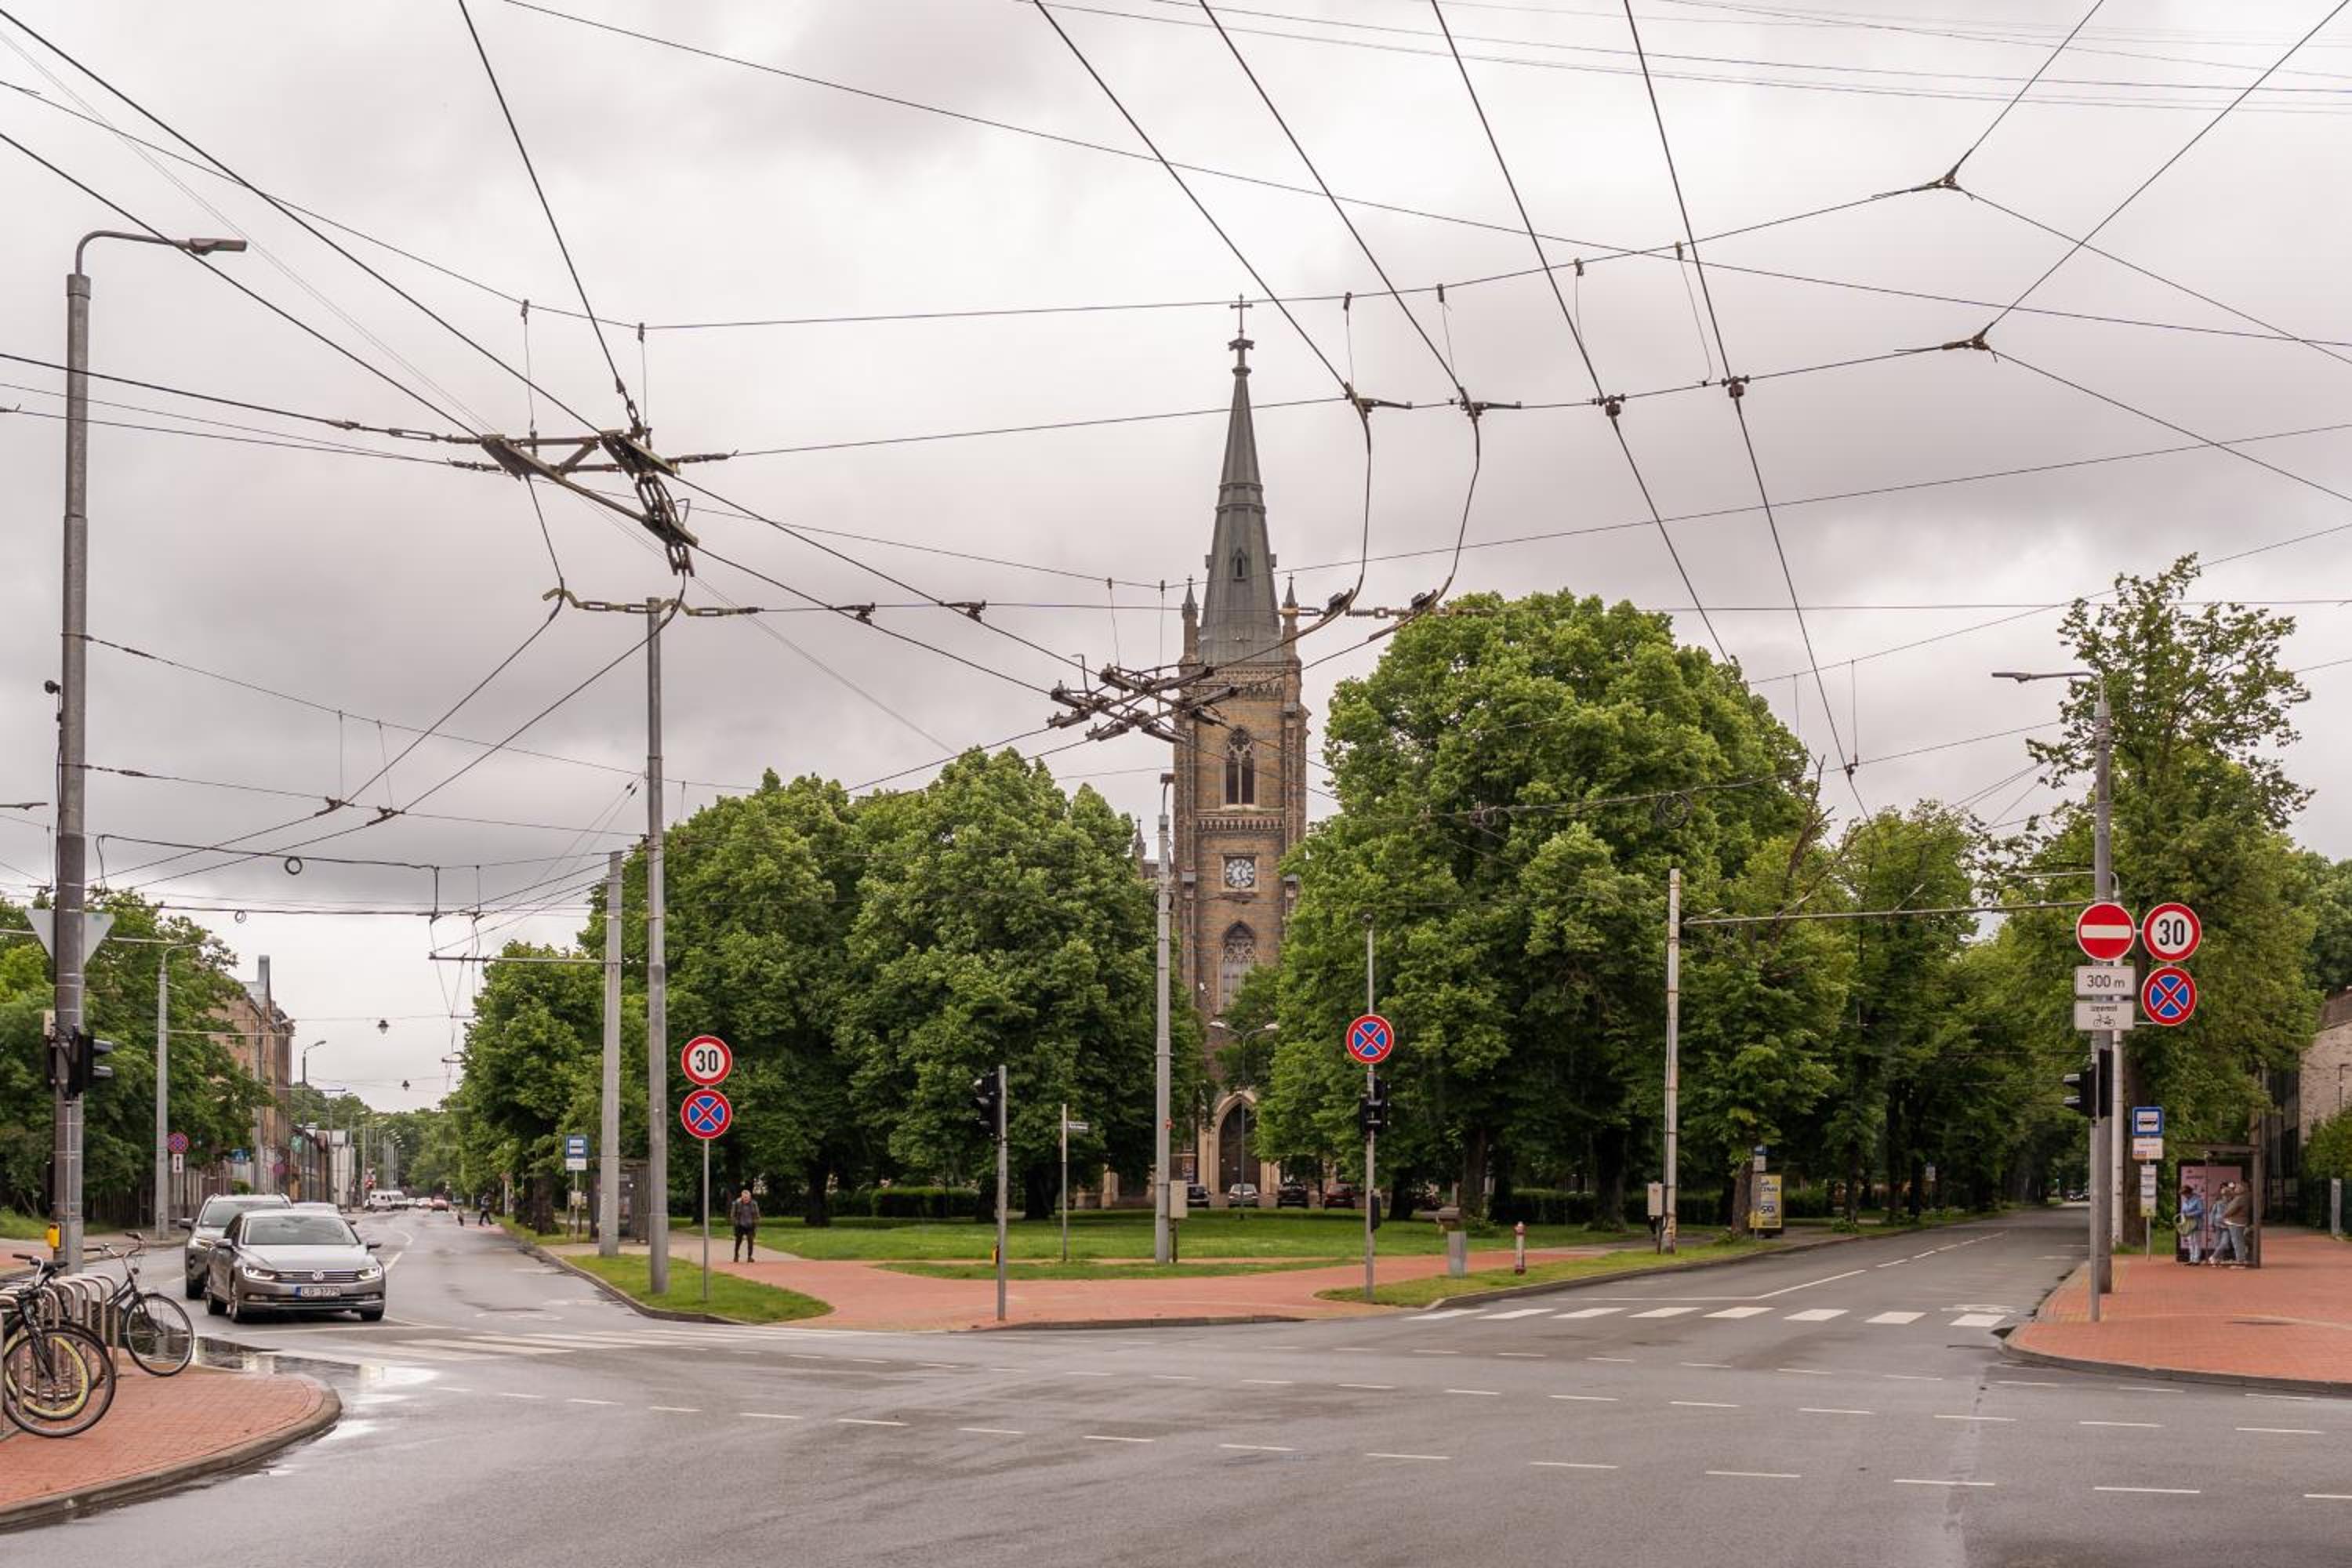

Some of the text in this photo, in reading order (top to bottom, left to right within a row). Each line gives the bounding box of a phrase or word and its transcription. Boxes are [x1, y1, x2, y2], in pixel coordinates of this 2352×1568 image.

[2158, 918, 2185, 946] 30
[2087, 975, 2125, 989] 300 m
[695, 1049, 718, 1073] 30
